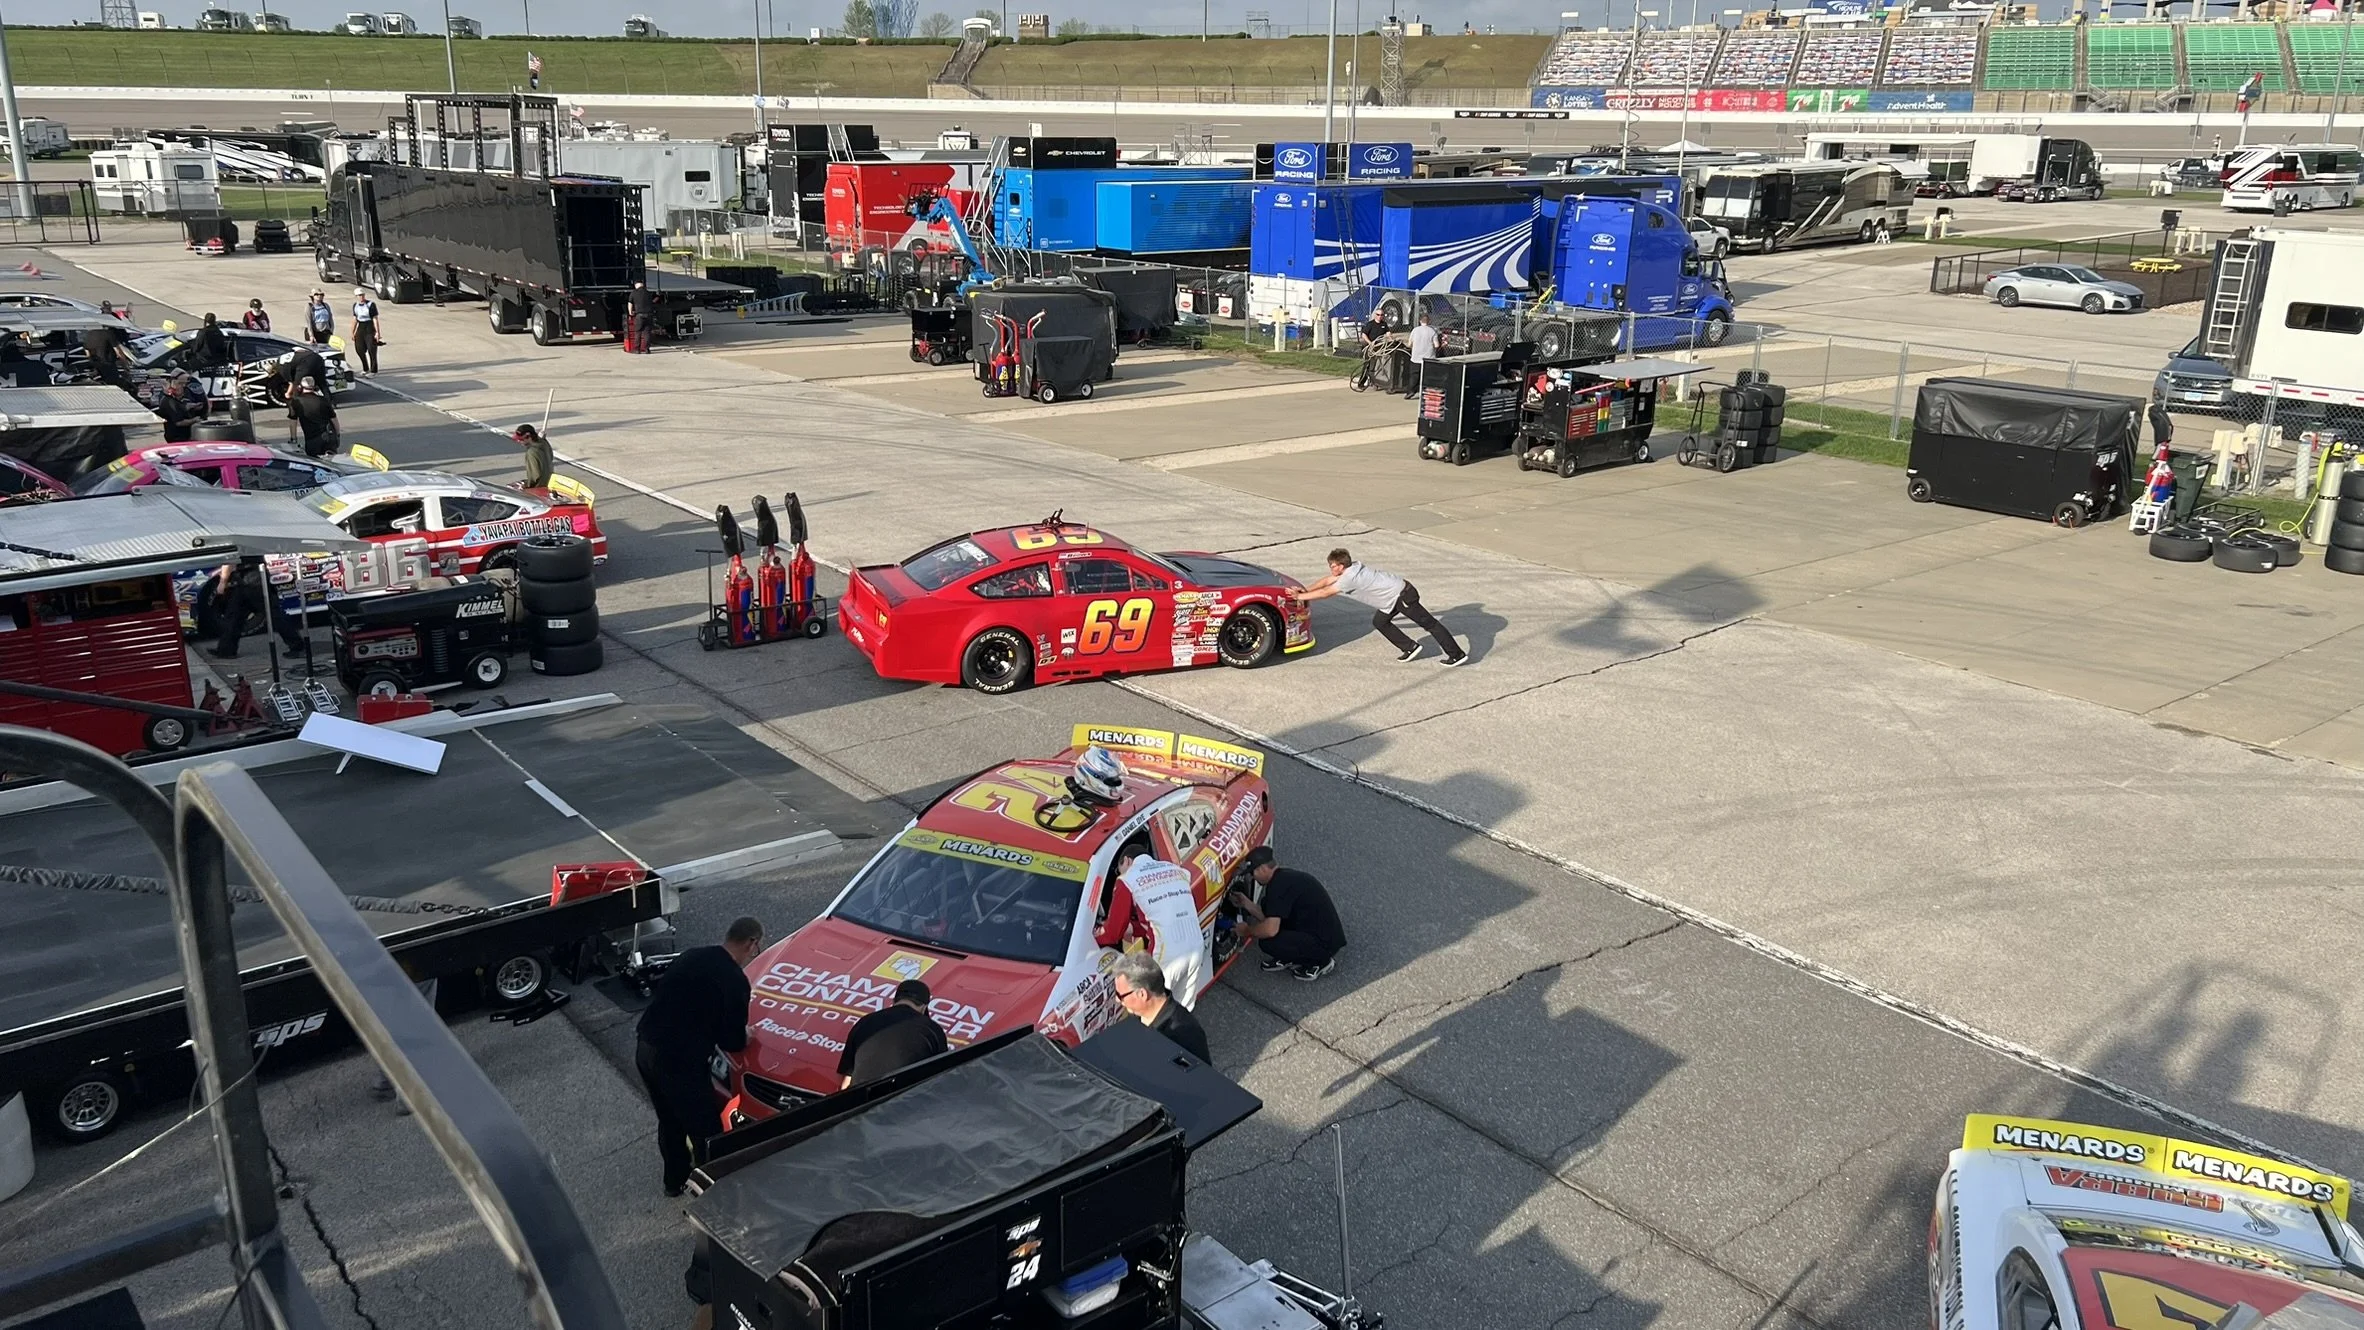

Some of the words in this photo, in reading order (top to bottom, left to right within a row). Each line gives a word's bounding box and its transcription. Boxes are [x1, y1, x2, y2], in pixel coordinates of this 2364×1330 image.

[771, 128, 791, 137] TOYOTA
[1275, 170, 1315, 179] RACING
[1360, 167, 1401, 175] RACING
[480, 521, 519, 541] YAVAPAI
[519, 517, 554, 536] BOTTLE
[553, 515, 572, 534] GAS
[341, 537, 432, 594] 86
[1174, 580, 1183, 589] 3
[455, 599, 504, 619] KIMMEL
[1238, 608, 1273, 633] GENERAL
[980, 631, 1020, 646] GENERAL
[1077, 597, 1155, 656] 69
[975, 677, 1017, 693] GENERAL
[1088, 728, 1166, 748] MENARDS
[1180, 741, 1258, 769] MENARDS
[1121, 820, 1138, 838] DANIEL
[1208, 790, 1258, 852] CHAMPION
[1219, 801, 1263, 866] CONTAINER
[940, 839, 1034, 866] MENARDS
[755, 974, 984, 1040] CONTAER
[769, 962, 996, 1026] CHAMON
[254, 1011, 328, 1048] sps
[756, 1017, 795, 1039] Race
[807, 1033, 847, 1053] Stop
[1993, 1123, 2146, 1164] MENARDS
[2043, 1164, 2224, 1214] COBRA
[2172, 1149, 2335, 1204] MENARDS
[1006, 1215, 1042, 1241] sps
[1006, 1253, 1042, 1291] 24
